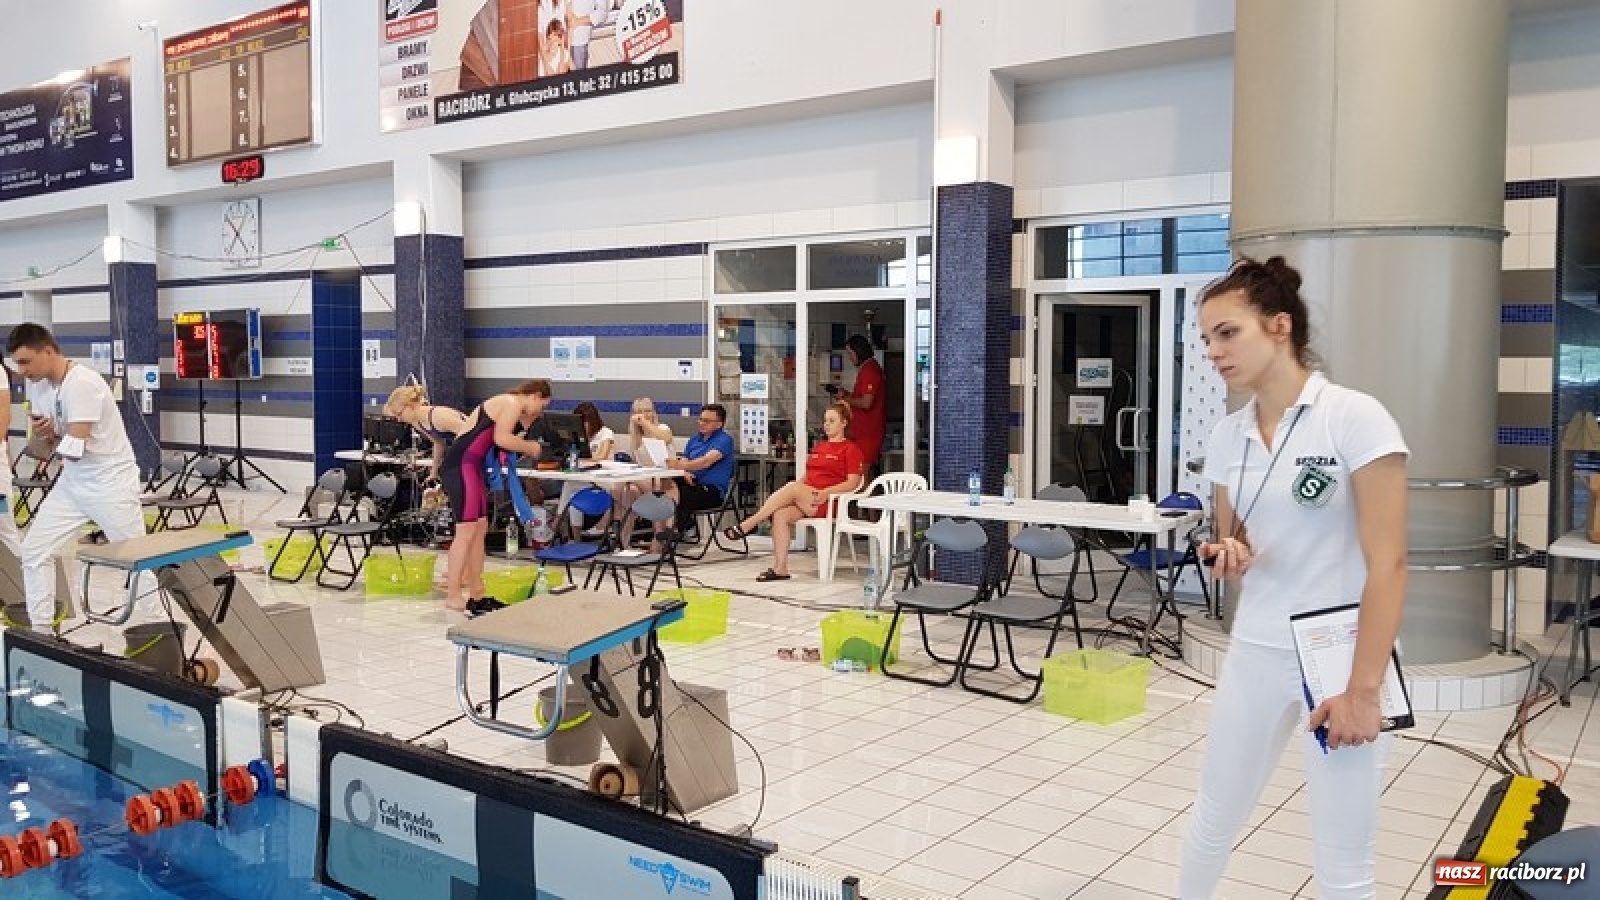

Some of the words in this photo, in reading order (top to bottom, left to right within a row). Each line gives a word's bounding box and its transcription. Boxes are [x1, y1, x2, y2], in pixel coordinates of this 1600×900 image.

[622, 2, 661, 32] -15%
[398, 41, 427, 60] BRAMY
[402, 62, 429, 80] DRZWI
[398, 83, 429, 101] PANELE
[438, 92, 491, 118] RACIBÓRZ
[598, 73, 611, 90] 32
[620, 69, 641, 86] 415
[642, 65, 657, 82] 25
[659, 63, 673, 79] 00
[406, 103, 429, 121] OKNA
[224, 159, 260, 180] 16:29
[1301, 479, 1321, 498] S
[213, 574, 237, 625] 7
[637, 655, 660, 719] 8
